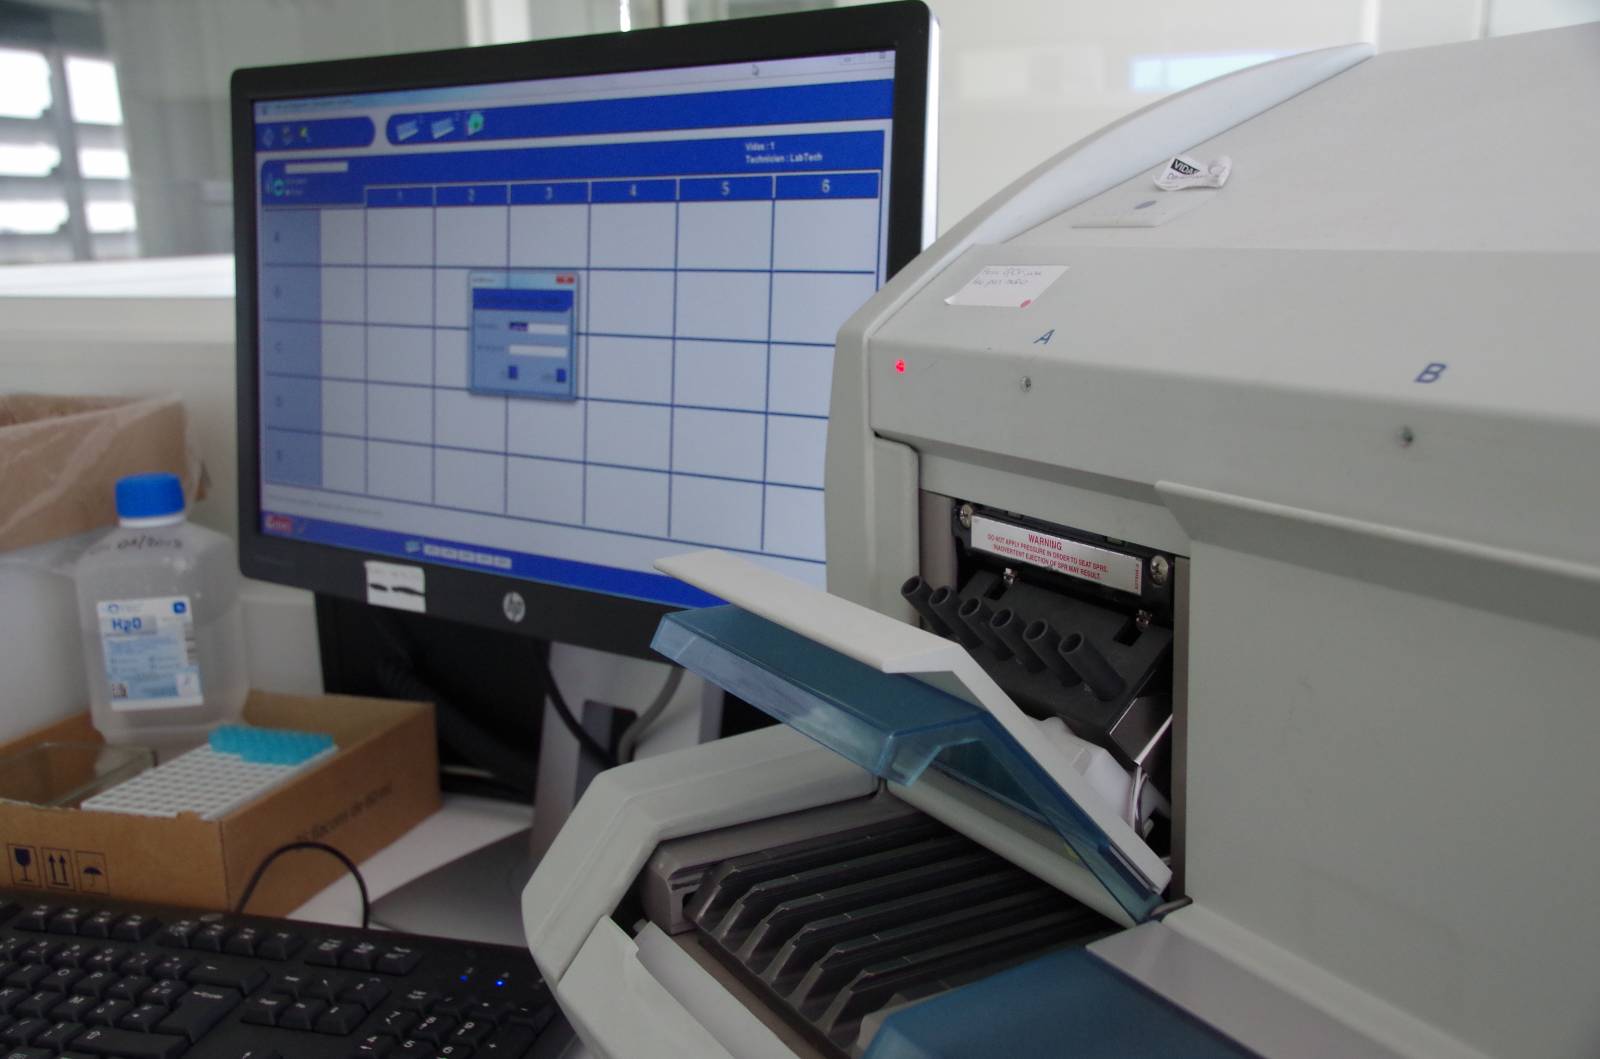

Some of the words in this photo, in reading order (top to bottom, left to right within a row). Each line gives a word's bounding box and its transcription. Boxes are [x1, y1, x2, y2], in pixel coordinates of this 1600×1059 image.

[745, 154, 785, 164] Technician
[790, 152, 823, 163] LabTech
[545, 186, 554, 201] 3
[629, 183, 637, 198] 4
[721, 181, 730, 196] 5
[821, 178, 830, 193] 6
[1033, 329, 1055, 345] A
[1414, 363, 1447, 384] B
[1005, 538, 1020, 548] APPLY
[1021, 542, 1046, 555] PRESSURE
[1028, 534, 1062, 551] WARNING
[1026, 553, 1049, 566] EJECTION
[1068, 565, 1079, 574] MAY
